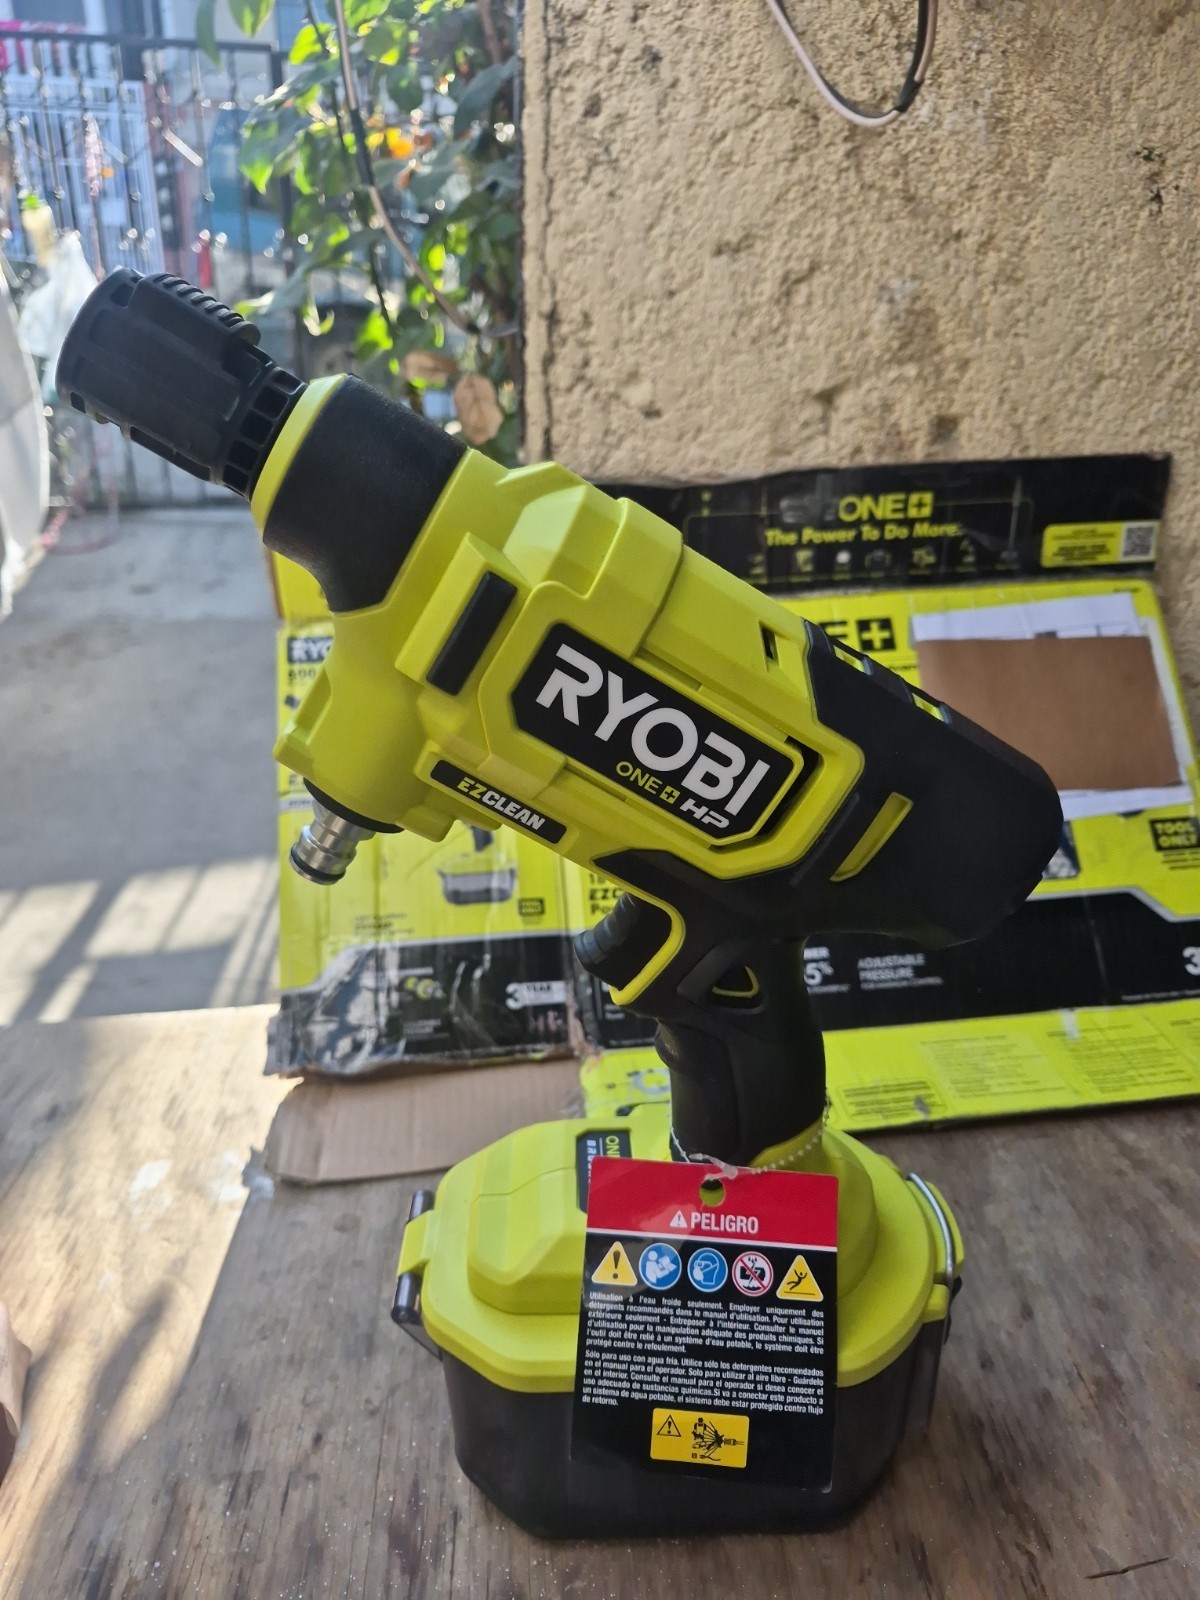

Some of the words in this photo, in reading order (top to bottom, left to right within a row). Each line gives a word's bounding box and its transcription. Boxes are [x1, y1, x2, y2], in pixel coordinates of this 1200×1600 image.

[765, 527, 798, 546] The
[801, 526, 857, 545] Power
[861, 523, 880, 540] To
[884, 522, 909, 539] Do
[535, 643, 771, 816] RYOBI
[456, 777, 546, 831] EZCLEAN
[680, 799, 730, 829] HP
[505, 982, 525, 1010] 3
[690, 1211, 759, 1234] PELIGRO
[589, 1301, 624, 1311] détergents
[627, 1304, 674, 1314] recommandés
[676, 1308, 692, 1316] dans
[695, 1309, 700, 1317] le
[703, 1309, 727, 1318] manuel
[773, 1316, 788, 1324] Pour
[791, 1318, 824, 1326] utilisation
[590, 1292, 623, 1302] Utilisation
[662, 1297, 681, 1306] froide
[688, 1300, 723, 1309] seulement.
[730, 1303, 760, 1313] Employer
[766, 1306, 805, 1316] uniquement
[588, 1310, 622, 1320] extérieure
[625, 1314, 660, 1323] seulement
[670, 1316, 705, 1327] Entreposer
[754, 1323, 785, 1332] Consulter
[789, 1326, 795, 1334] le
[799, 1327, 824, 1335] manuel
[586, 1338, 612, 1347] protégé
[637, 1341, 643, 1349] le
[644, 1342, 686, 1352] refoulement.
[609, 1330, 621, 1338] doit
[624, 1331, 637, 1339] être
[640, 1333, 654, 1341] relié
[657, 1334, 661, 1342] à
[675, 1335, 703, 1345] système
[727, 1339, 753, 1349] potable,
[756, 1341, 762, 1349] le
[765, 1343, 792, 1352] système
[795, 1345, 808, 1353] doit
[810, 1346, 824, 1354] être
[656, 1325, 699, 1335] manipulation
[702, 1329, 732, 1339] adéquate
[735, 1331, 746, 1339] des
[749, 1332, 776, 1341] produits
[779, 1333, 814, 1344] chimiques.
[817, 1337, 824, 1345] Si
[602, 1353, 617, 1361] para
[648, 1357, 664, 1365] agua
[681, 1358, 702, 1367] Utilice
[720, 1361, 730, 1369] los
[732, 1362, 772, 1372] detergentes
[774, 1366, 823, 1376] recomendados
[603, 1361, 628, 1369] manual
[630, 1364, 645, 1372] para
[655, 1366, 686, 1375] operador.
[722, 1371, 745, 1380] utilizar
[748, 1373, 753, 1381] al
[756, 1374, 768, 1382] aire
[771, 1375, 786, 1383] libre
[597, 1379, 630, 1388] adecuado
[643, 1383, 679, 1392] sustancias
[739, 1391, 768, 1400] conectar
[786, 1395, 817, 1404] producto
[603, 1370, 628, 1379] interior.
[631, 1373, 660, 1382] Consulte
[671, 1376, 696, 1385] manual
[724, 1381, 754, 1390] operador
[765, 1383, 785, 1392] desea
[788, 1386, 815, 1395] conocer
[592, 1397, 618, 1406] retorno.
[593, 1387, 619, 1397] sistema
[631, 1392, 647, 1400] agua
[649, 1393, 676, 1402] potable,
[685, 1396, 712, 1405] sistema
[713, 1398, 729, 1406] debe
[731, 1400, 748, 1408] estar
[750, 1402, 783, 1412] protegido
[784, 1404, 806, 1413] contra
[808, 1406, 823, 1415] flujo
